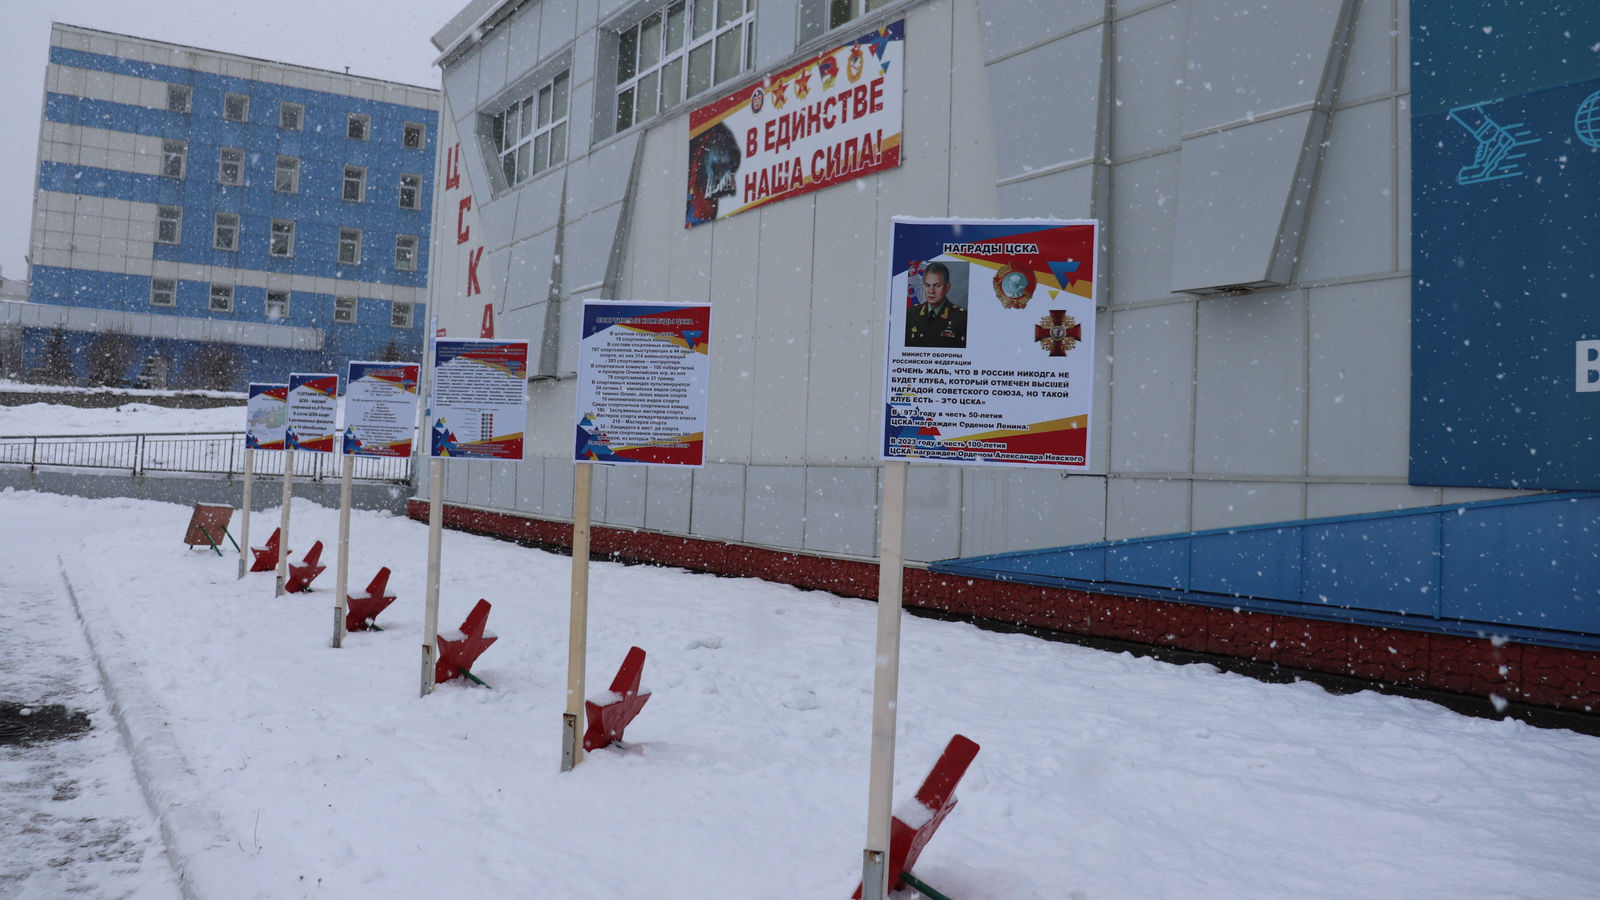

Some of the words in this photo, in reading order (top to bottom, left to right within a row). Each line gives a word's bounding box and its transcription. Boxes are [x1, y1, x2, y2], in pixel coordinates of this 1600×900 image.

[746, 126, 758, 158] В
[764, 77, 884, 153] ЕДИНСТВЕ
[744, 156, 803, 203] НАША
[811, 129, 883, 183] СИЛА!
[943, 243, 1001, 254] НАГРАДЫ
[1005, 243, 1039, 254] ЦСКА
[925, 368, 952, 376] ЖАЛЬ,
[1017, 370, 1056, 378] НИКОДГА
[919, 377, 947, 385] КЛУБА,
[949, 378, 989, 386] КОТОРЫЙ
[990, 379, 1030, 387] ОТМЕЧЕН
[1032, 380, 1070, 388] ВЫСШЕЙ
[891, 386, 934, 394] НАГРАДОЙ
[936, 387, 989, 396] СОВЕТСКОГО
[992, 389, 1024, 397] СОЮЗА,
[1041, 390, 1069, 398] ТАКОЙ
[915, 420, 957, 428] награжден
[967, 441, 1006, 449] 100-летия
[913, 449, 956, 457] награжден
[958, 450, 993, 458] Орденом
[995, 452, 1043, 461] Александра
[1045, 453, 1083, 462] Невского
